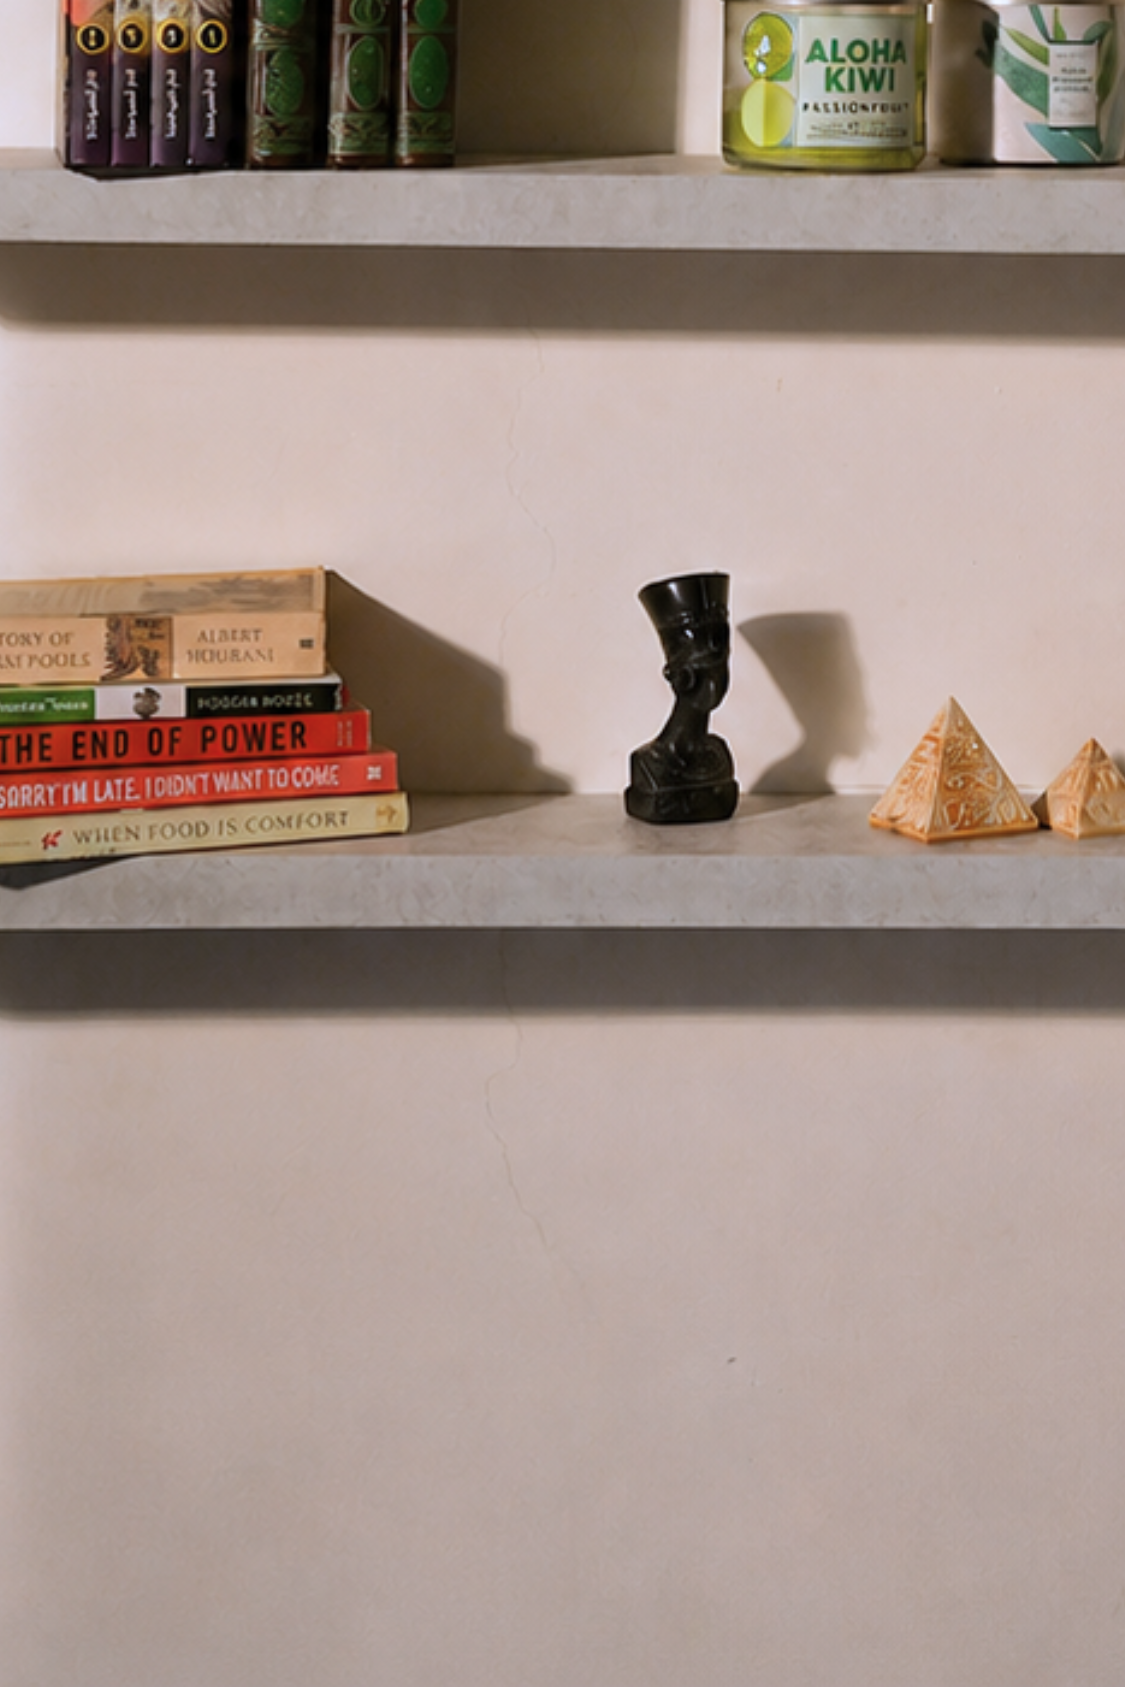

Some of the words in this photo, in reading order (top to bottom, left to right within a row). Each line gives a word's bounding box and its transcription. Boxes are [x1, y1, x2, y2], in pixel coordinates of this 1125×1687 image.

[804, 37, 907, 64] ALOHA
[824, 66, 895, 93] KIWI
[195, 628, 263, 643] ALBERT
[0, 730, 53, 764] THE
[72, 728, 129, 761] END
[147, 725, 182, 757] OF
[200, 720, 308, 753] POWER
[0, 782, 60, 810] SORRY
[145, 776, 151, 799] I
[212, 768, 264, 793] WANT
[267, 765, 290, 789] TO
[291, 764, 341, 789] COME
[72, 824, 140, 844] WHEN
[148, 819, 210, 840] FOOD
[218, 816, 238, 836] IS
[244, 810, 350, 833] COMFORT
